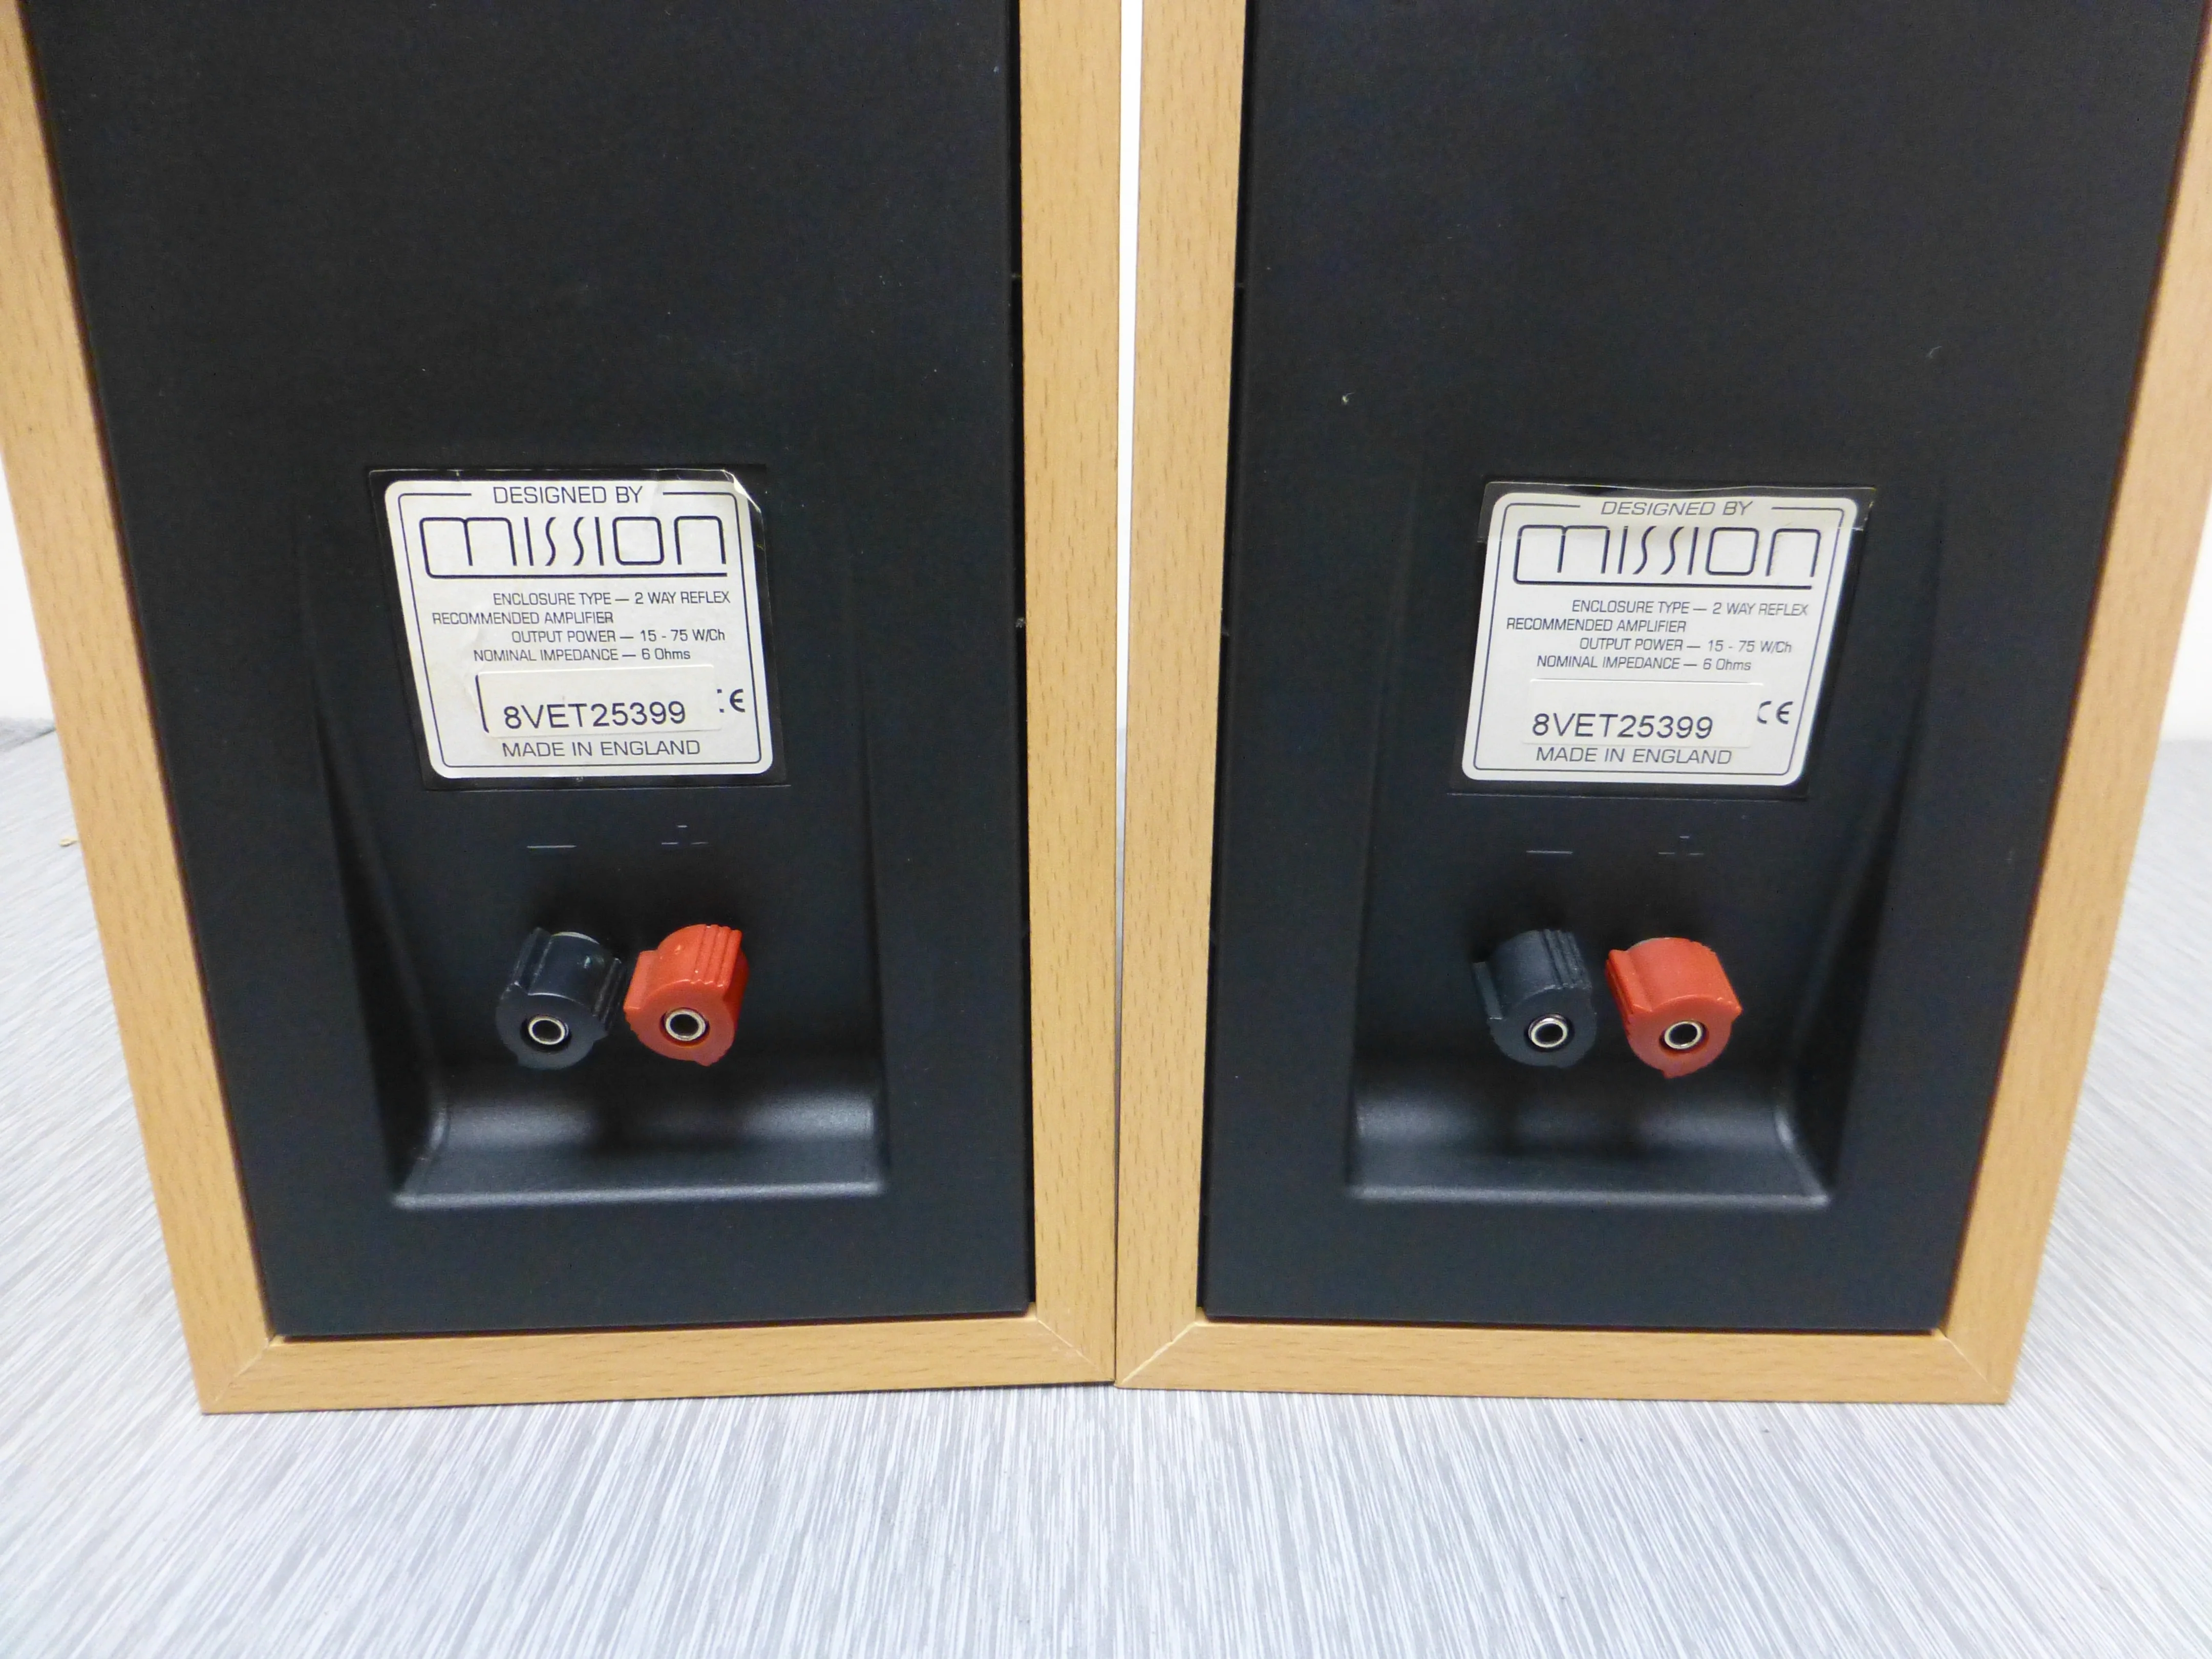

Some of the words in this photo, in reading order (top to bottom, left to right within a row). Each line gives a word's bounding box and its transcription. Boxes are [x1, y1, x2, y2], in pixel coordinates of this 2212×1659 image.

[493, 486, 607, 504] DESIGNED
[615, 485, 643, 503] BY
[1601, 501, 1716, 516] DESIGNED
[1722, 501, 1753, 516] BY
[493, 592, 576, 605] ENCLOSURE
[578, 592, 612, 605] TYPE
[634, 592, 644, 604] 2
[647, 591, 676, 604] WAY
[680, 591, 731, 604] REFLEX
[1572, 600, 1654, 613] ENCLOSURE
[1657, 601, 1690, 614] TYPE
[1712, 602, 1722, 614] 2
[1727, 603, 1756, 614] WAY
[1758, 603, 1809, 616] REFLEX
[432, 612, 540, 625] RECOMMENDED
[544, 611, 614, 624] AMPLIFIER
[1506, 618, 1613, 631] RECOMMENDED
[1616, 620, 1687, 632] AMPLIFIER
[512, 630, 563, 643] OUTPUT
[567, 630, 616, 643] POWER
[640, 629, 657, 642] 15
[670, 629, 688, 642] 75
[692, 629, 725, 642] W/Ch
[1580, 637, 1632, 650] OUTPUT
[1634, 639, 1683, 651] POWER
[1709, 640, 1724, 652] 15
[1738, 640, 1755, 652] 75
[1760, 641, 1792, 653] W/Ch
[473, 649, 537, 662] NOMINAL
[540, 648, 619, 661] IMPEDANCE
[642, 648, 651, 660] 6
[654, 648, 691, 661] Ohms
[1537, 655, 1598, 668] NOMINAL
[1603, 656, 1681, 669] IMPEDANCE
[1703, 658, 1712, 670] 6
[1716, 658, 1751, 670] Ohms
[503, 700, 686, 729] 8VET25399
[1532, 713, 1713, 739] 8VET25399
[502, 742, 565, 757] MADE
[571, 741, 592, 756] IN
[600, 740, 700, 756] ENGLAND
[1536, 747, 1598, 762] MADE
[1605, 748, 1625, 762] IN
[1632, 746, 1732, 764] ENGLAND
